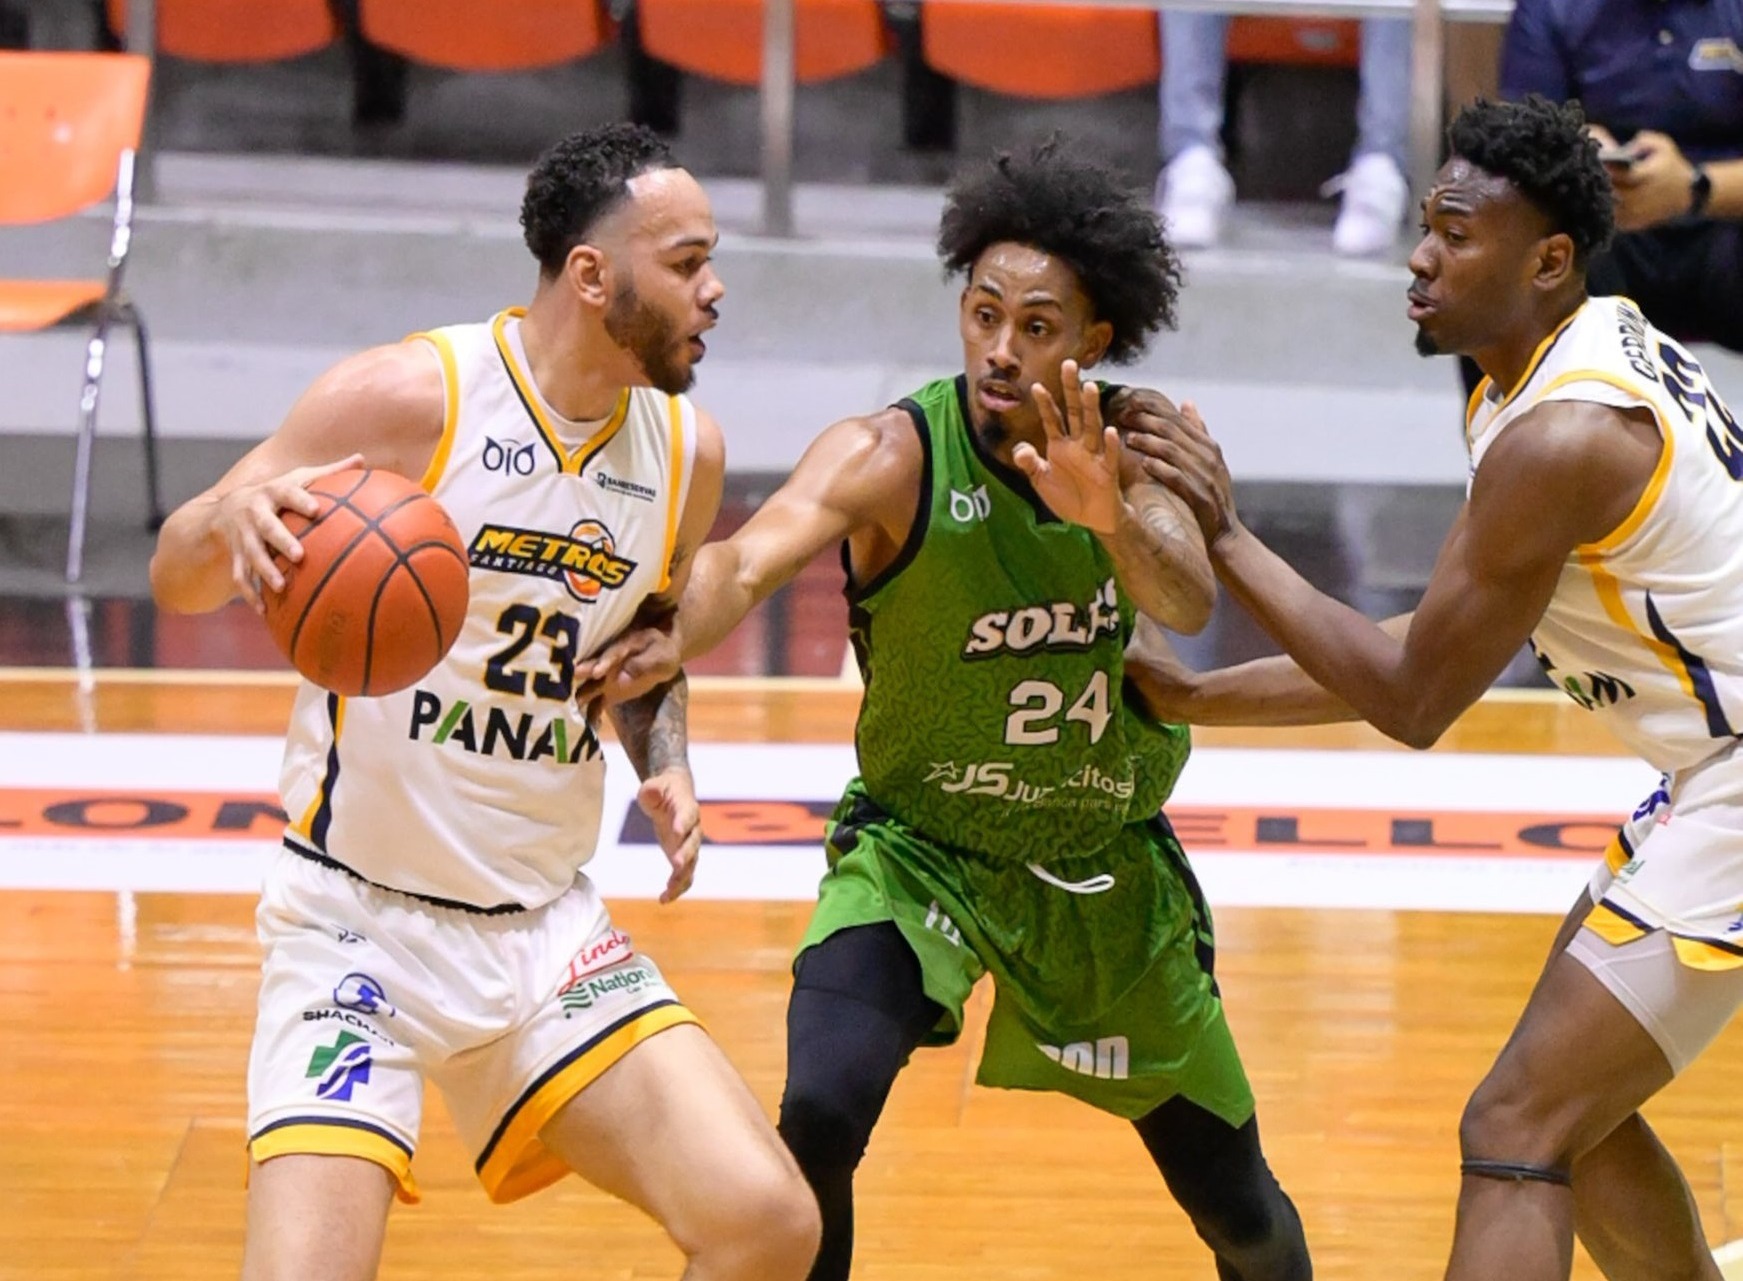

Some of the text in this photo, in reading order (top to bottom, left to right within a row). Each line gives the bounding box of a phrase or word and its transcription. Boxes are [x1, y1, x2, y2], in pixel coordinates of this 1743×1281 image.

[475, 529, 631, 585] METROS
[484, 603, 580, 702] 23
[1004, 670, 1112, 745] 24
[941, 762, 1014, 796] JS
[1160, 814, 1624, 852] ELLO
